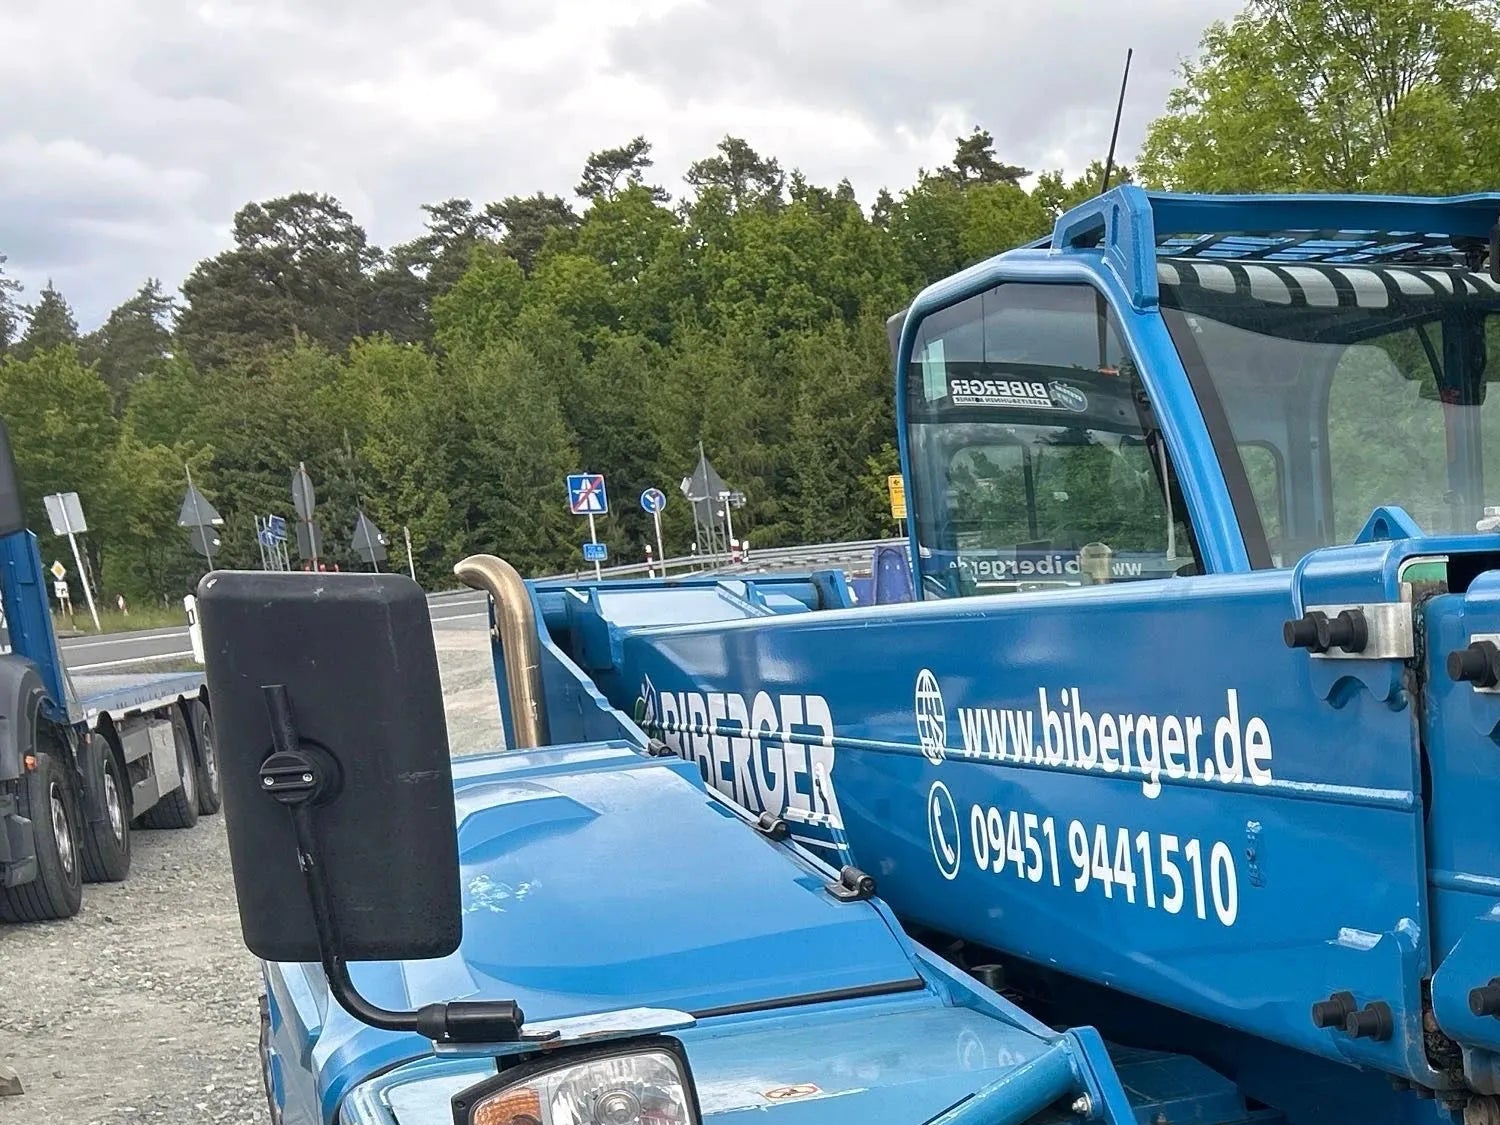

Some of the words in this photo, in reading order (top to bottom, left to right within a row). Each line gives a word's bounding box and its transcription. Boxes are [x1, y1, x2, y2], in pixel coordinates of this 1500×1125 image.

[660, 690, 845, 831] BIBERGER
[957, 686, 1274, 799] www.biberger.de
[970, 803, 1061, 887] 09451
[1067, 819, 1239, 927] 9441510
